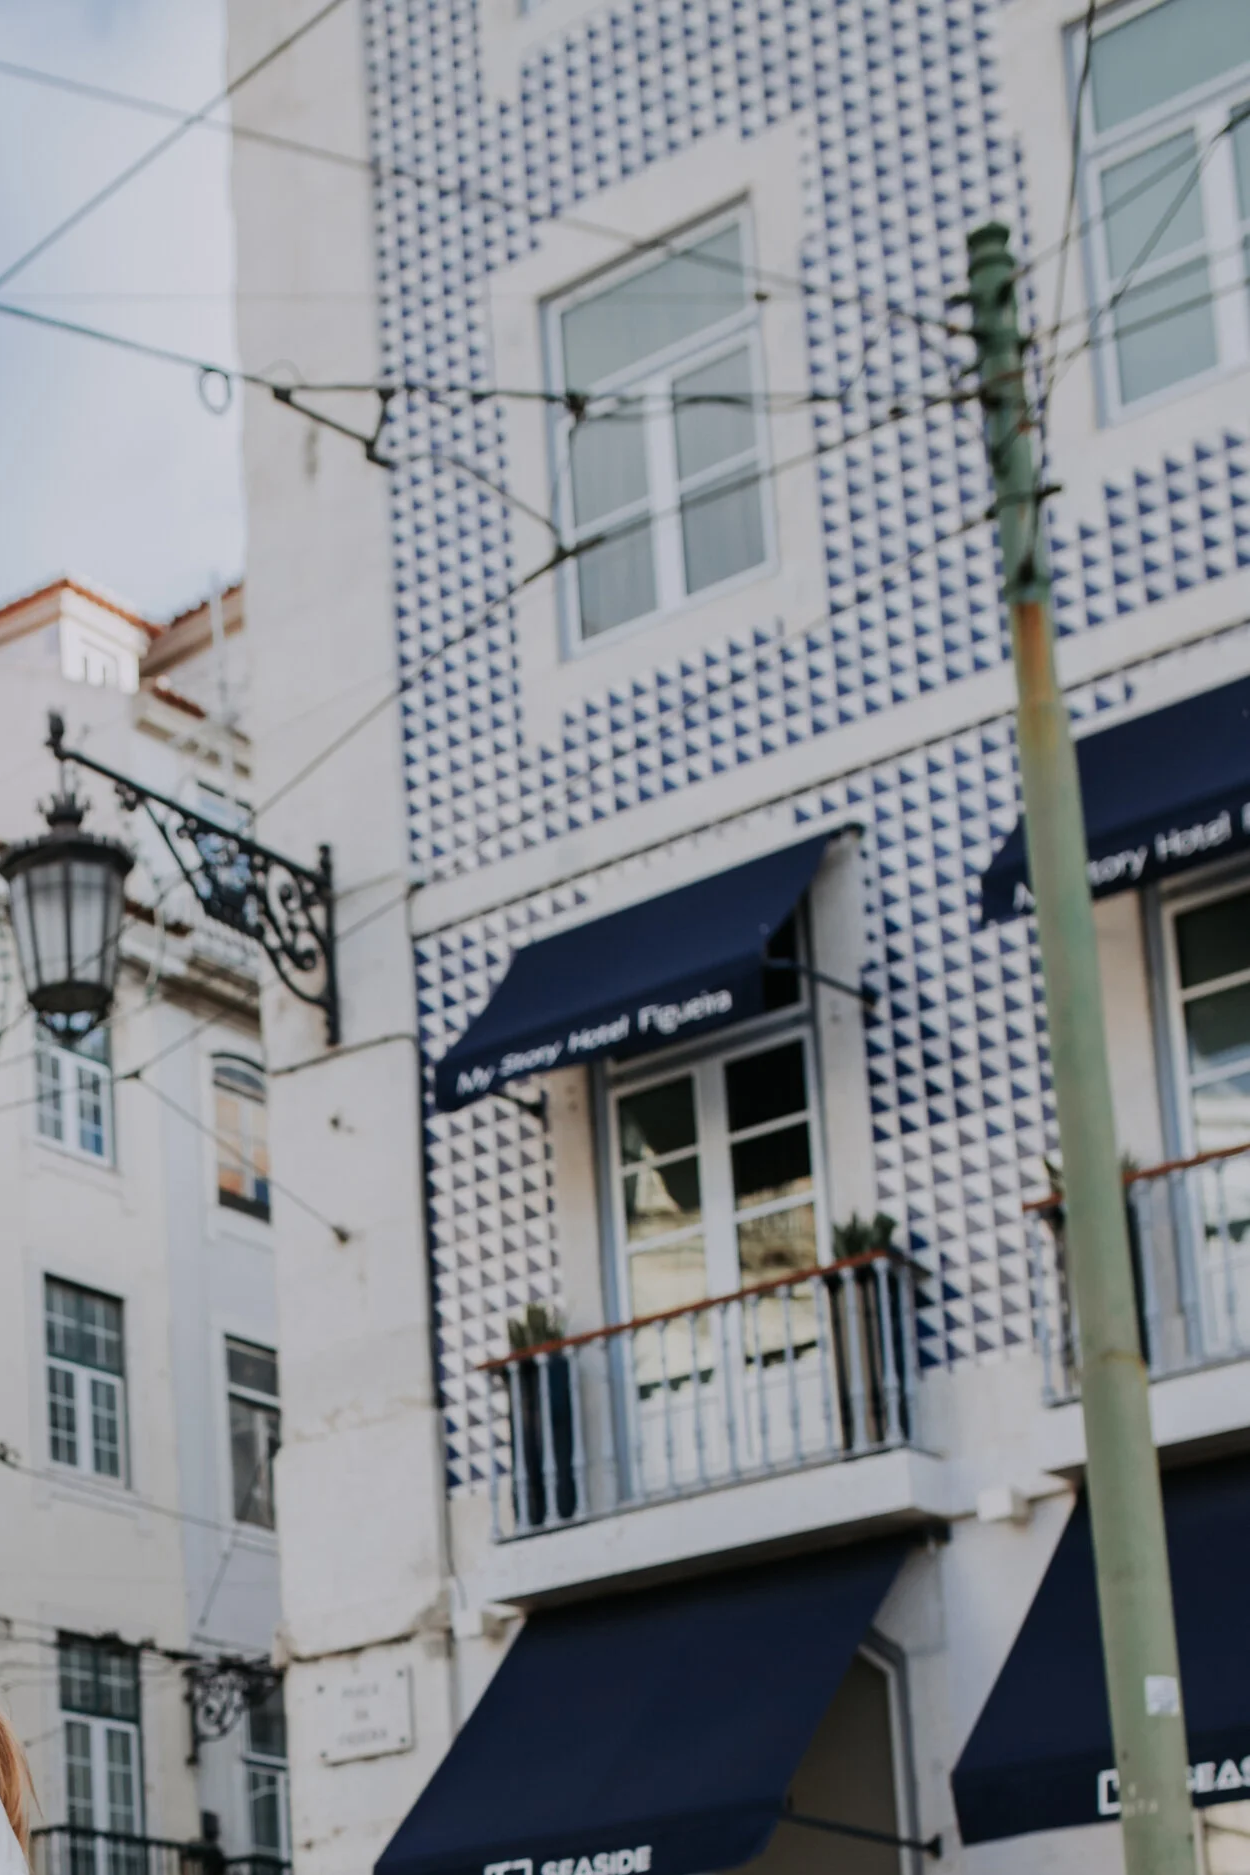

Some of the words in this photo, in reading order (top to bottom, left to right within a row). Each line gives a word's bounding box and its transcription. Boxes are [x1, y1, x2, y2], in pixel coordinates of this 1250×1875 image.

[1086, 845, 1149, 887] tory
[1154, 810, 1232, 863] Hotel
[456, 1065, 496, 1096] My
[500, 1040, 563, 1078] Story
[567, 1014, 631, 1054] Hotel
[637, 989, 733, 1035] Figueira
